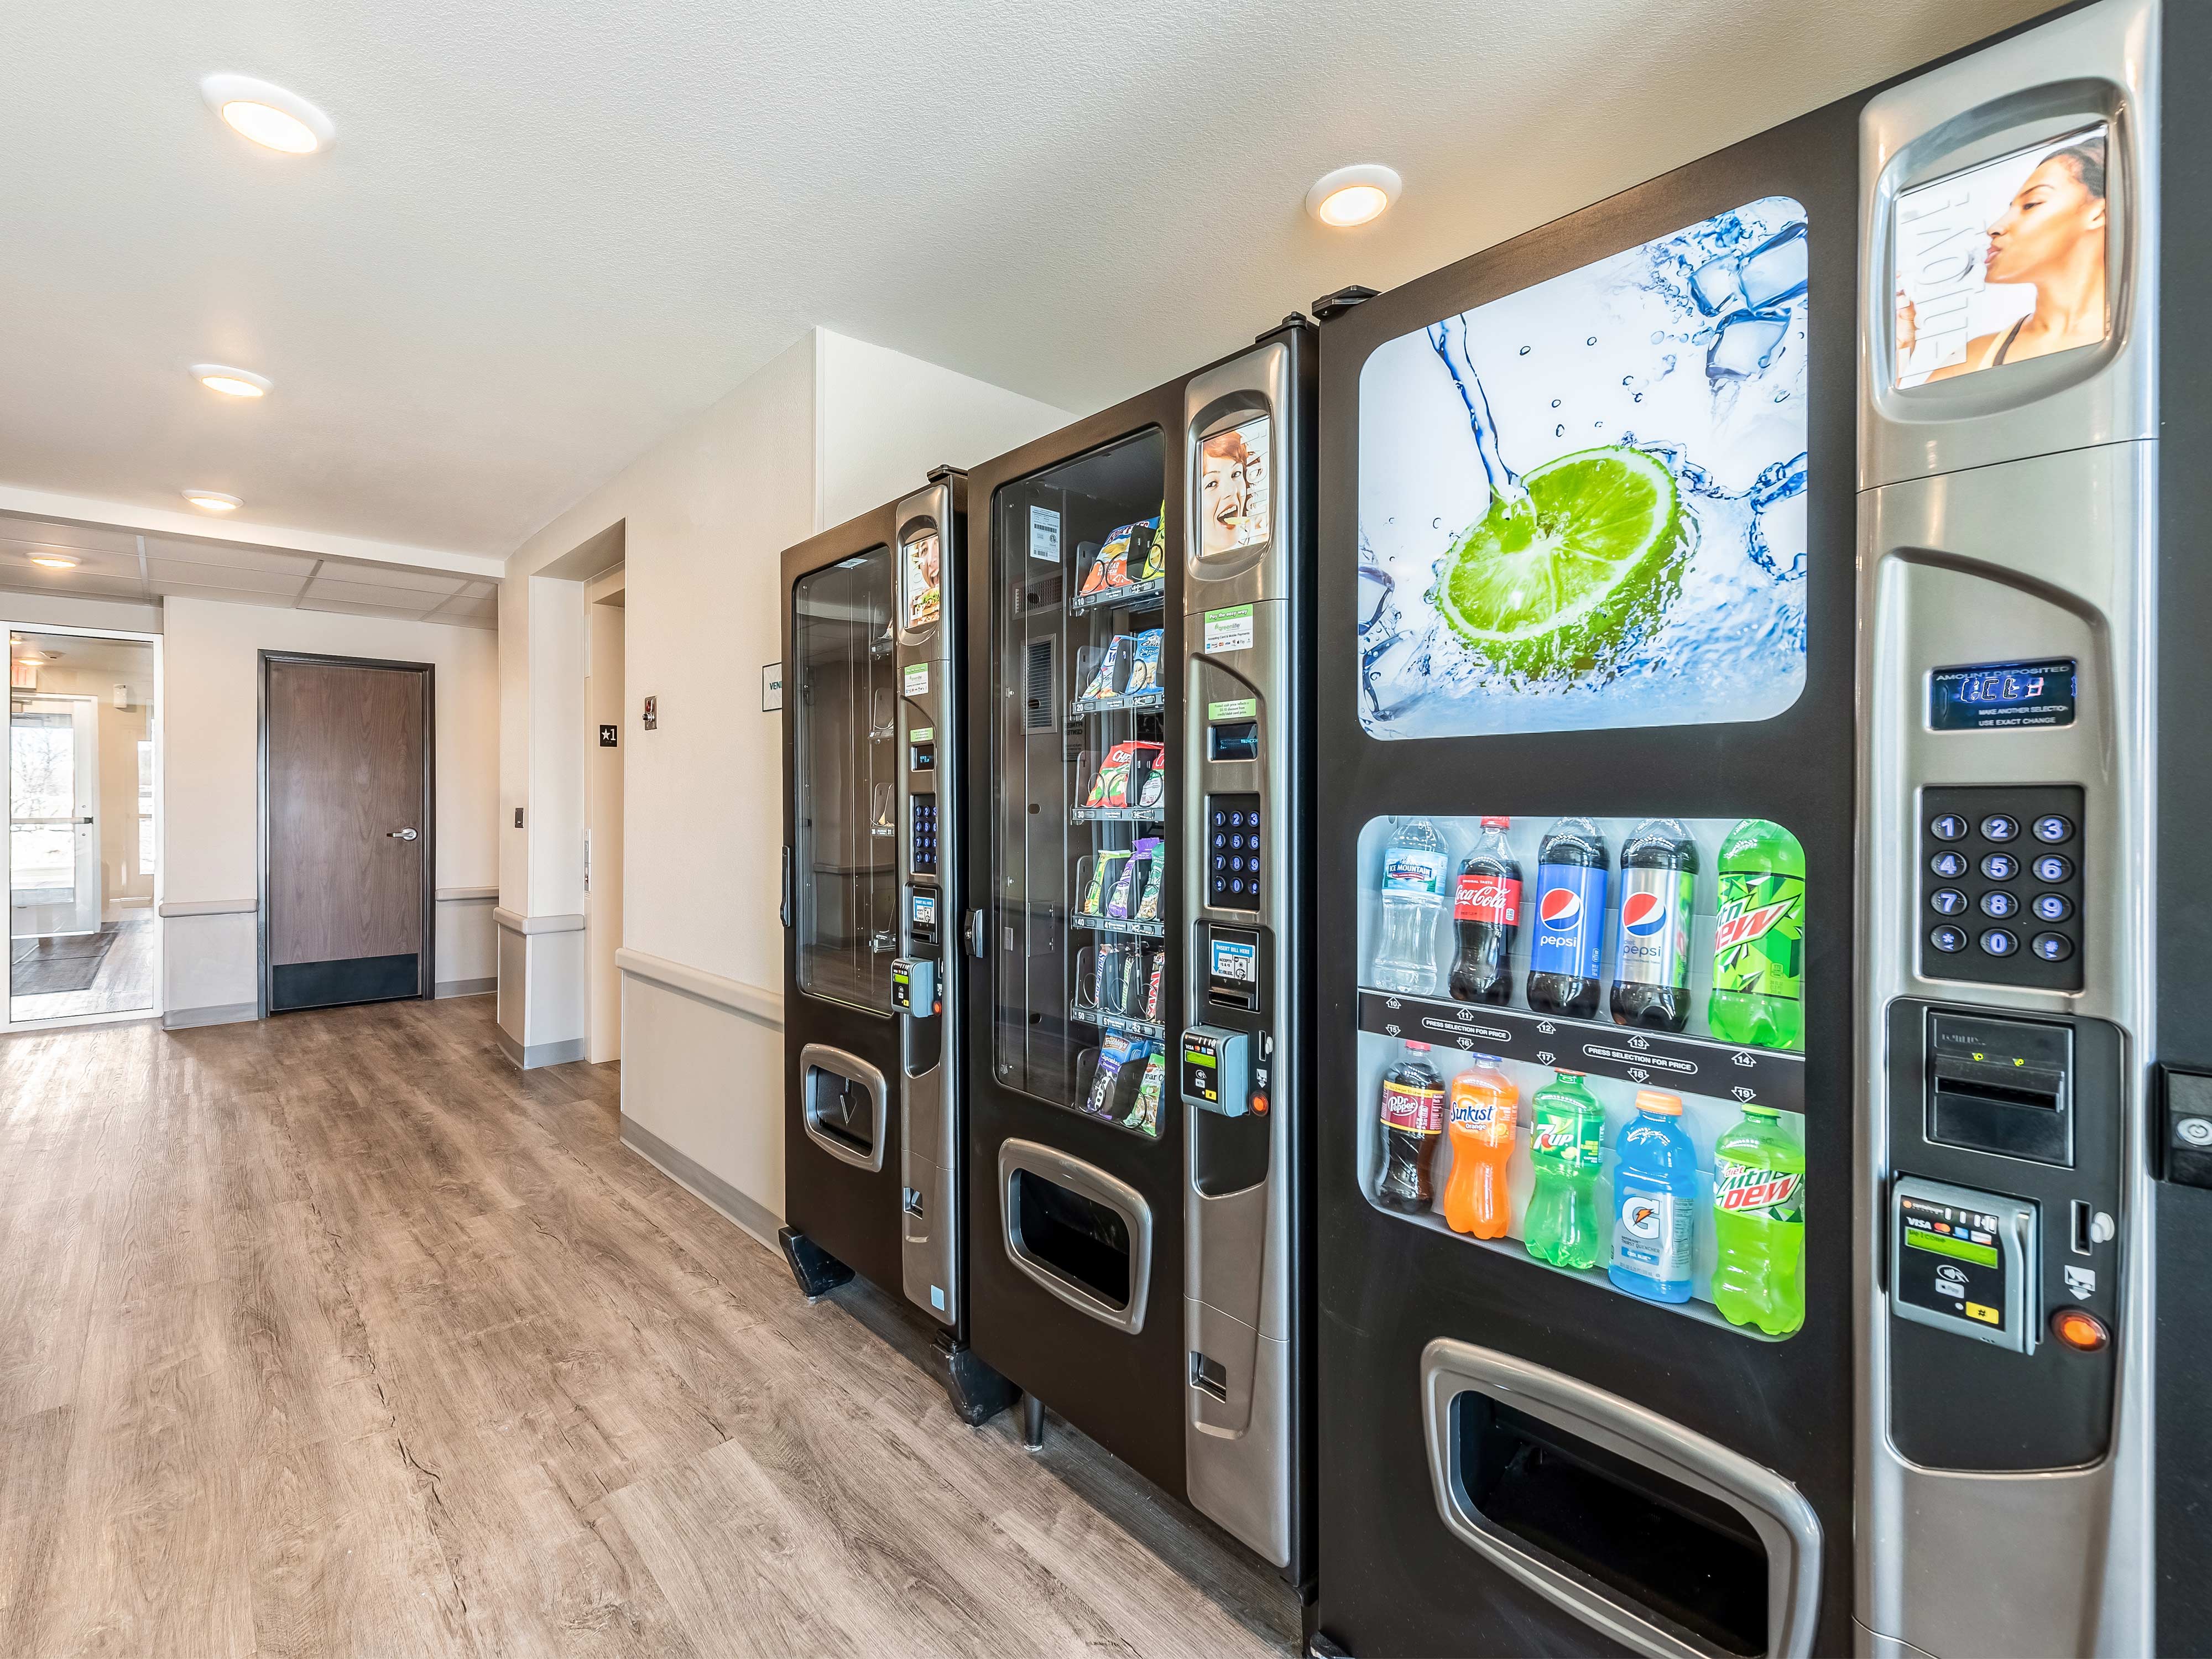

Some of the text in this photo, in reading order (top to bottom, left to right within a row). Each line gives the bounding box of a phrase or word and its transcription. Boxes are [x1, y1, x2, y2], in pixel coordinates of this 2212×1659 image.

[1936, 666, 2069, 681] AMOUNT DEPOSITED
[1077, 703, 1083, 712] 20
[610, 728, 616, 740] 1
[916, 807, 919, 816] 1
[925, 807, 928, 816] 2
[1217, 813, 1258, 825] 1 2 3
[916, 822, 920, 831] 4
[1941, 818, 2063, 839] 1 2 3
[916, 838, 920, 847] 7
[1216, 835, 1258, 848] 4 5 6
[1217, 857, 1258, 871] 7 8 9
[1397, 864, 1431, 877] MOUNTAIN
[1940, 855, 2062, 879] 4 5 6
[1234, 879, 1240, 891] 0
[1454, 884, 1511, 909] Coca-Cola
[1941, 893, 2063, 918] 7 8 9
[1540, 935, 1577, 947] pepsi
[1991, 933, 2007, 953] 0
[1623, 945, 1661, 958] pepsi
[1078, 1011, 1084, 1020] 50
[1103, 1017, 1109, 1025] 51
[1426, 1020, 1506, 1039] PRESS SELECTION FOR PRICE
[1101, 1052, 1120, 1067] Cupcakes
[1588, 1047, 1692, 1071] PRESS SELECTION FOR PRICE
[1738, 1056, 1750, 1064] 14
[1397, 1095, 1409, 1104] Dr
[1738, 1089, 1750, 1098] 19
[1390, 1097, 1416, 1114] Pepper
[1451, 1102, 1496, 1123] Sunkist
[1725, 1167, 1744, 1177] diet
[1622, 1196, 1660, 1240] G
[1906, 1217, 1932, 1230] VISA
[1908, 1229, 1946, 1244] Welcome
[1621, 1238, 1660, 1253] THIRST QUENCHER
